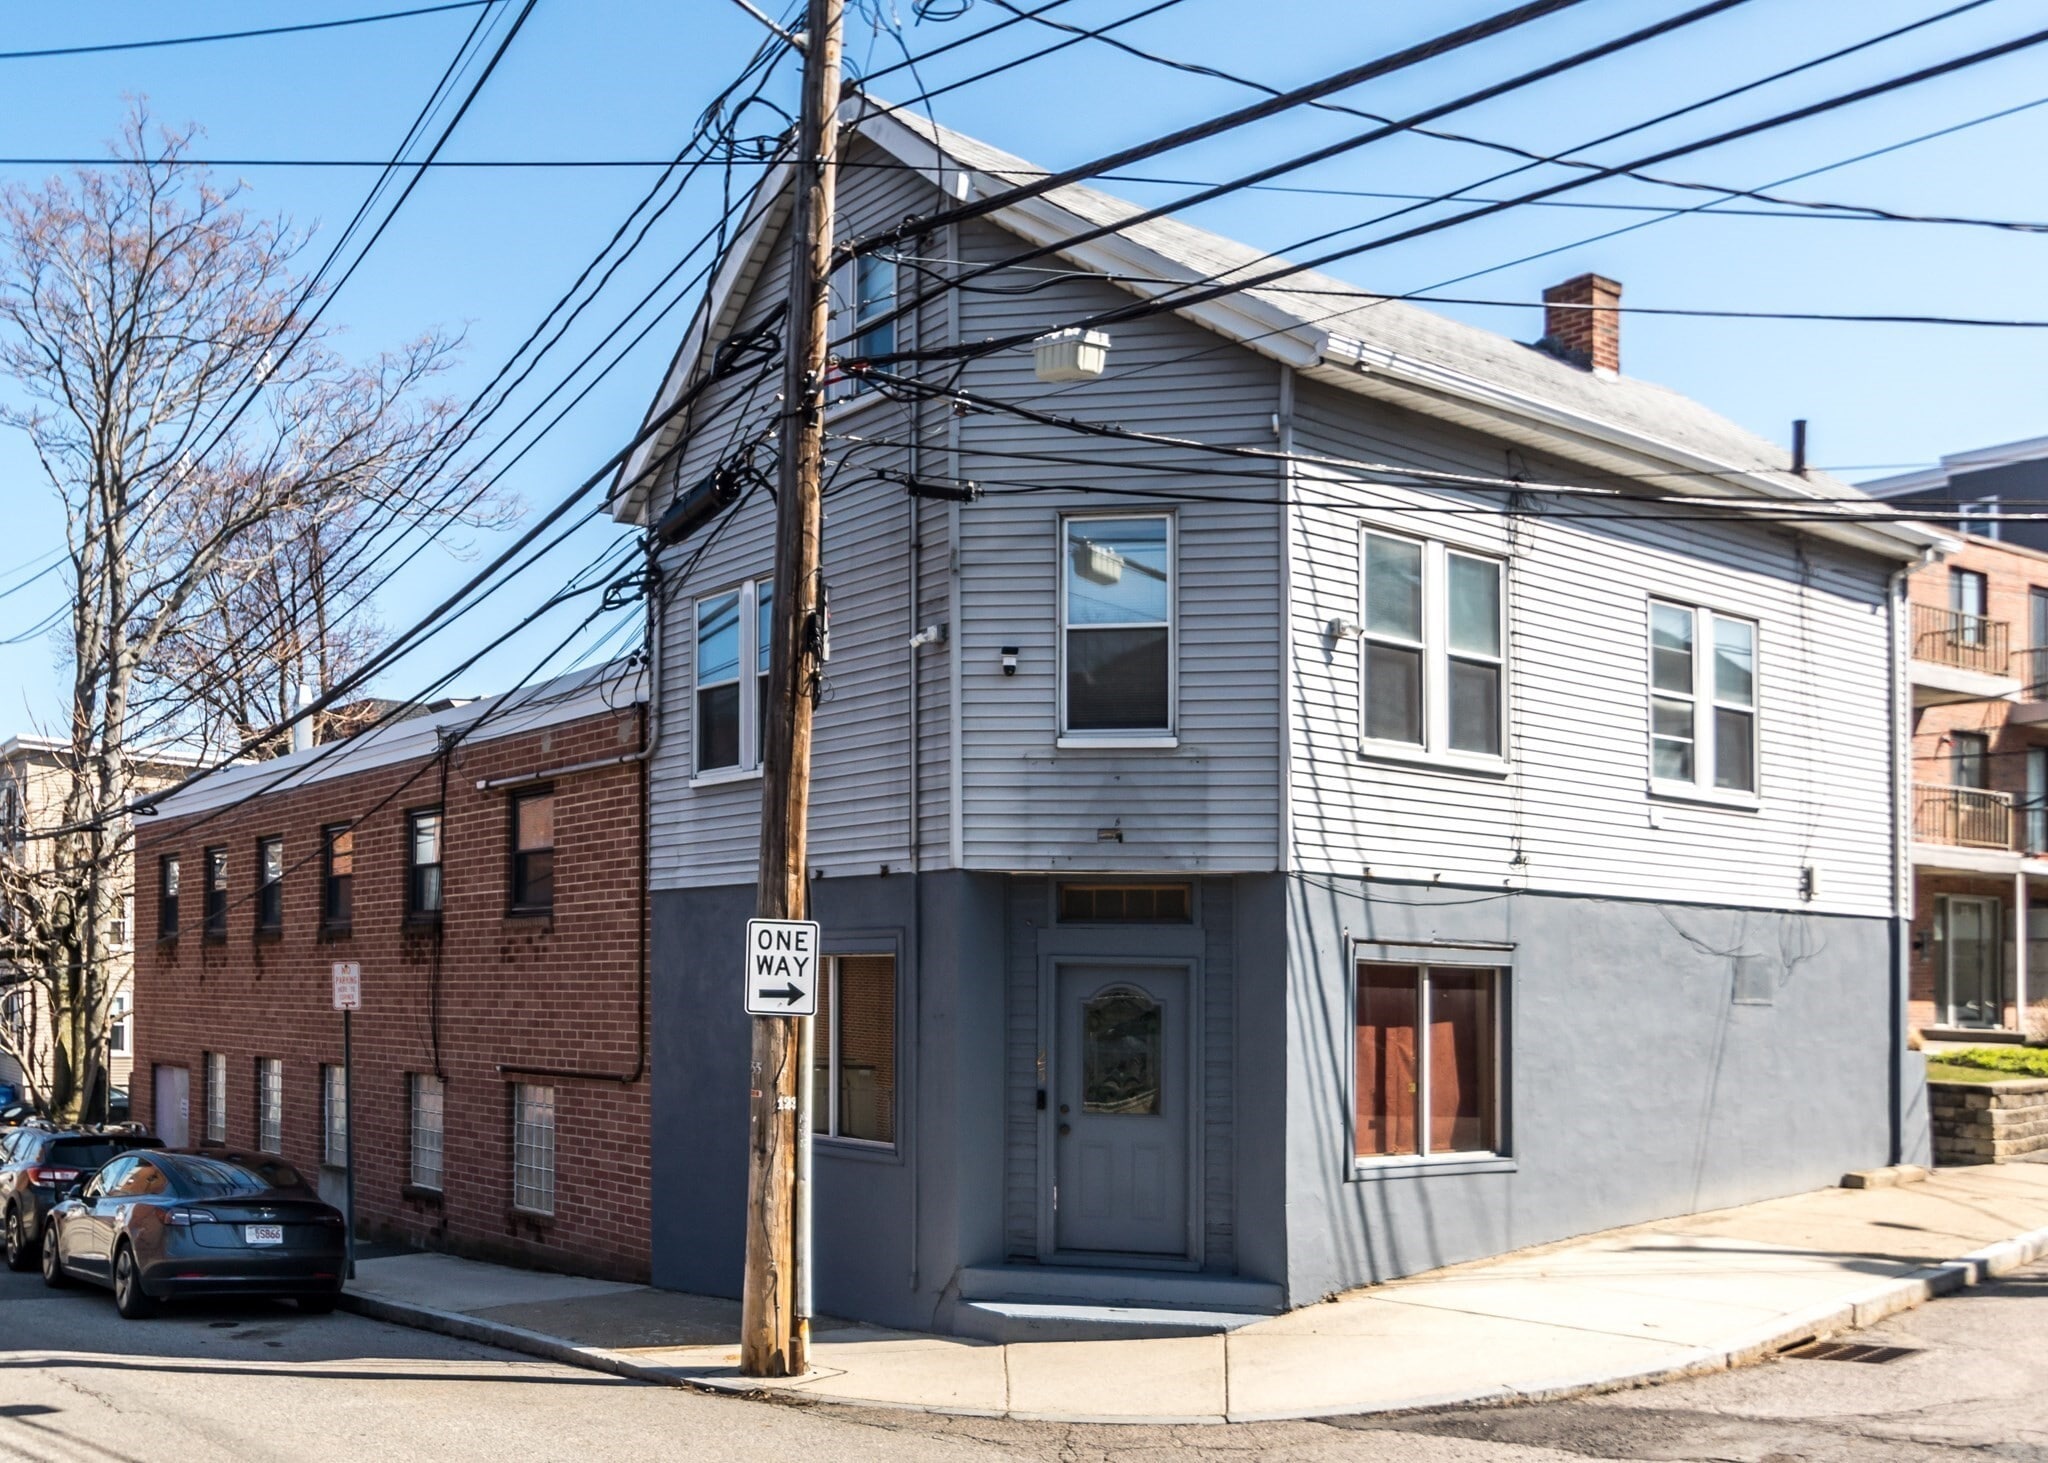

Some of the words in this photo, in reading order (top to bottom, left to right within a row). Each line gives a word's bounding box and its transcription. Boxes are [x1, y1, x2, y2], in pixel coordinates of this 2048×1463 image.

[758, 929, 808, 951] ONE
[341, 967, 351, 975] NO
[756, 954, 809, 977] WAY
[335, 976, 357, 984] PARKING
